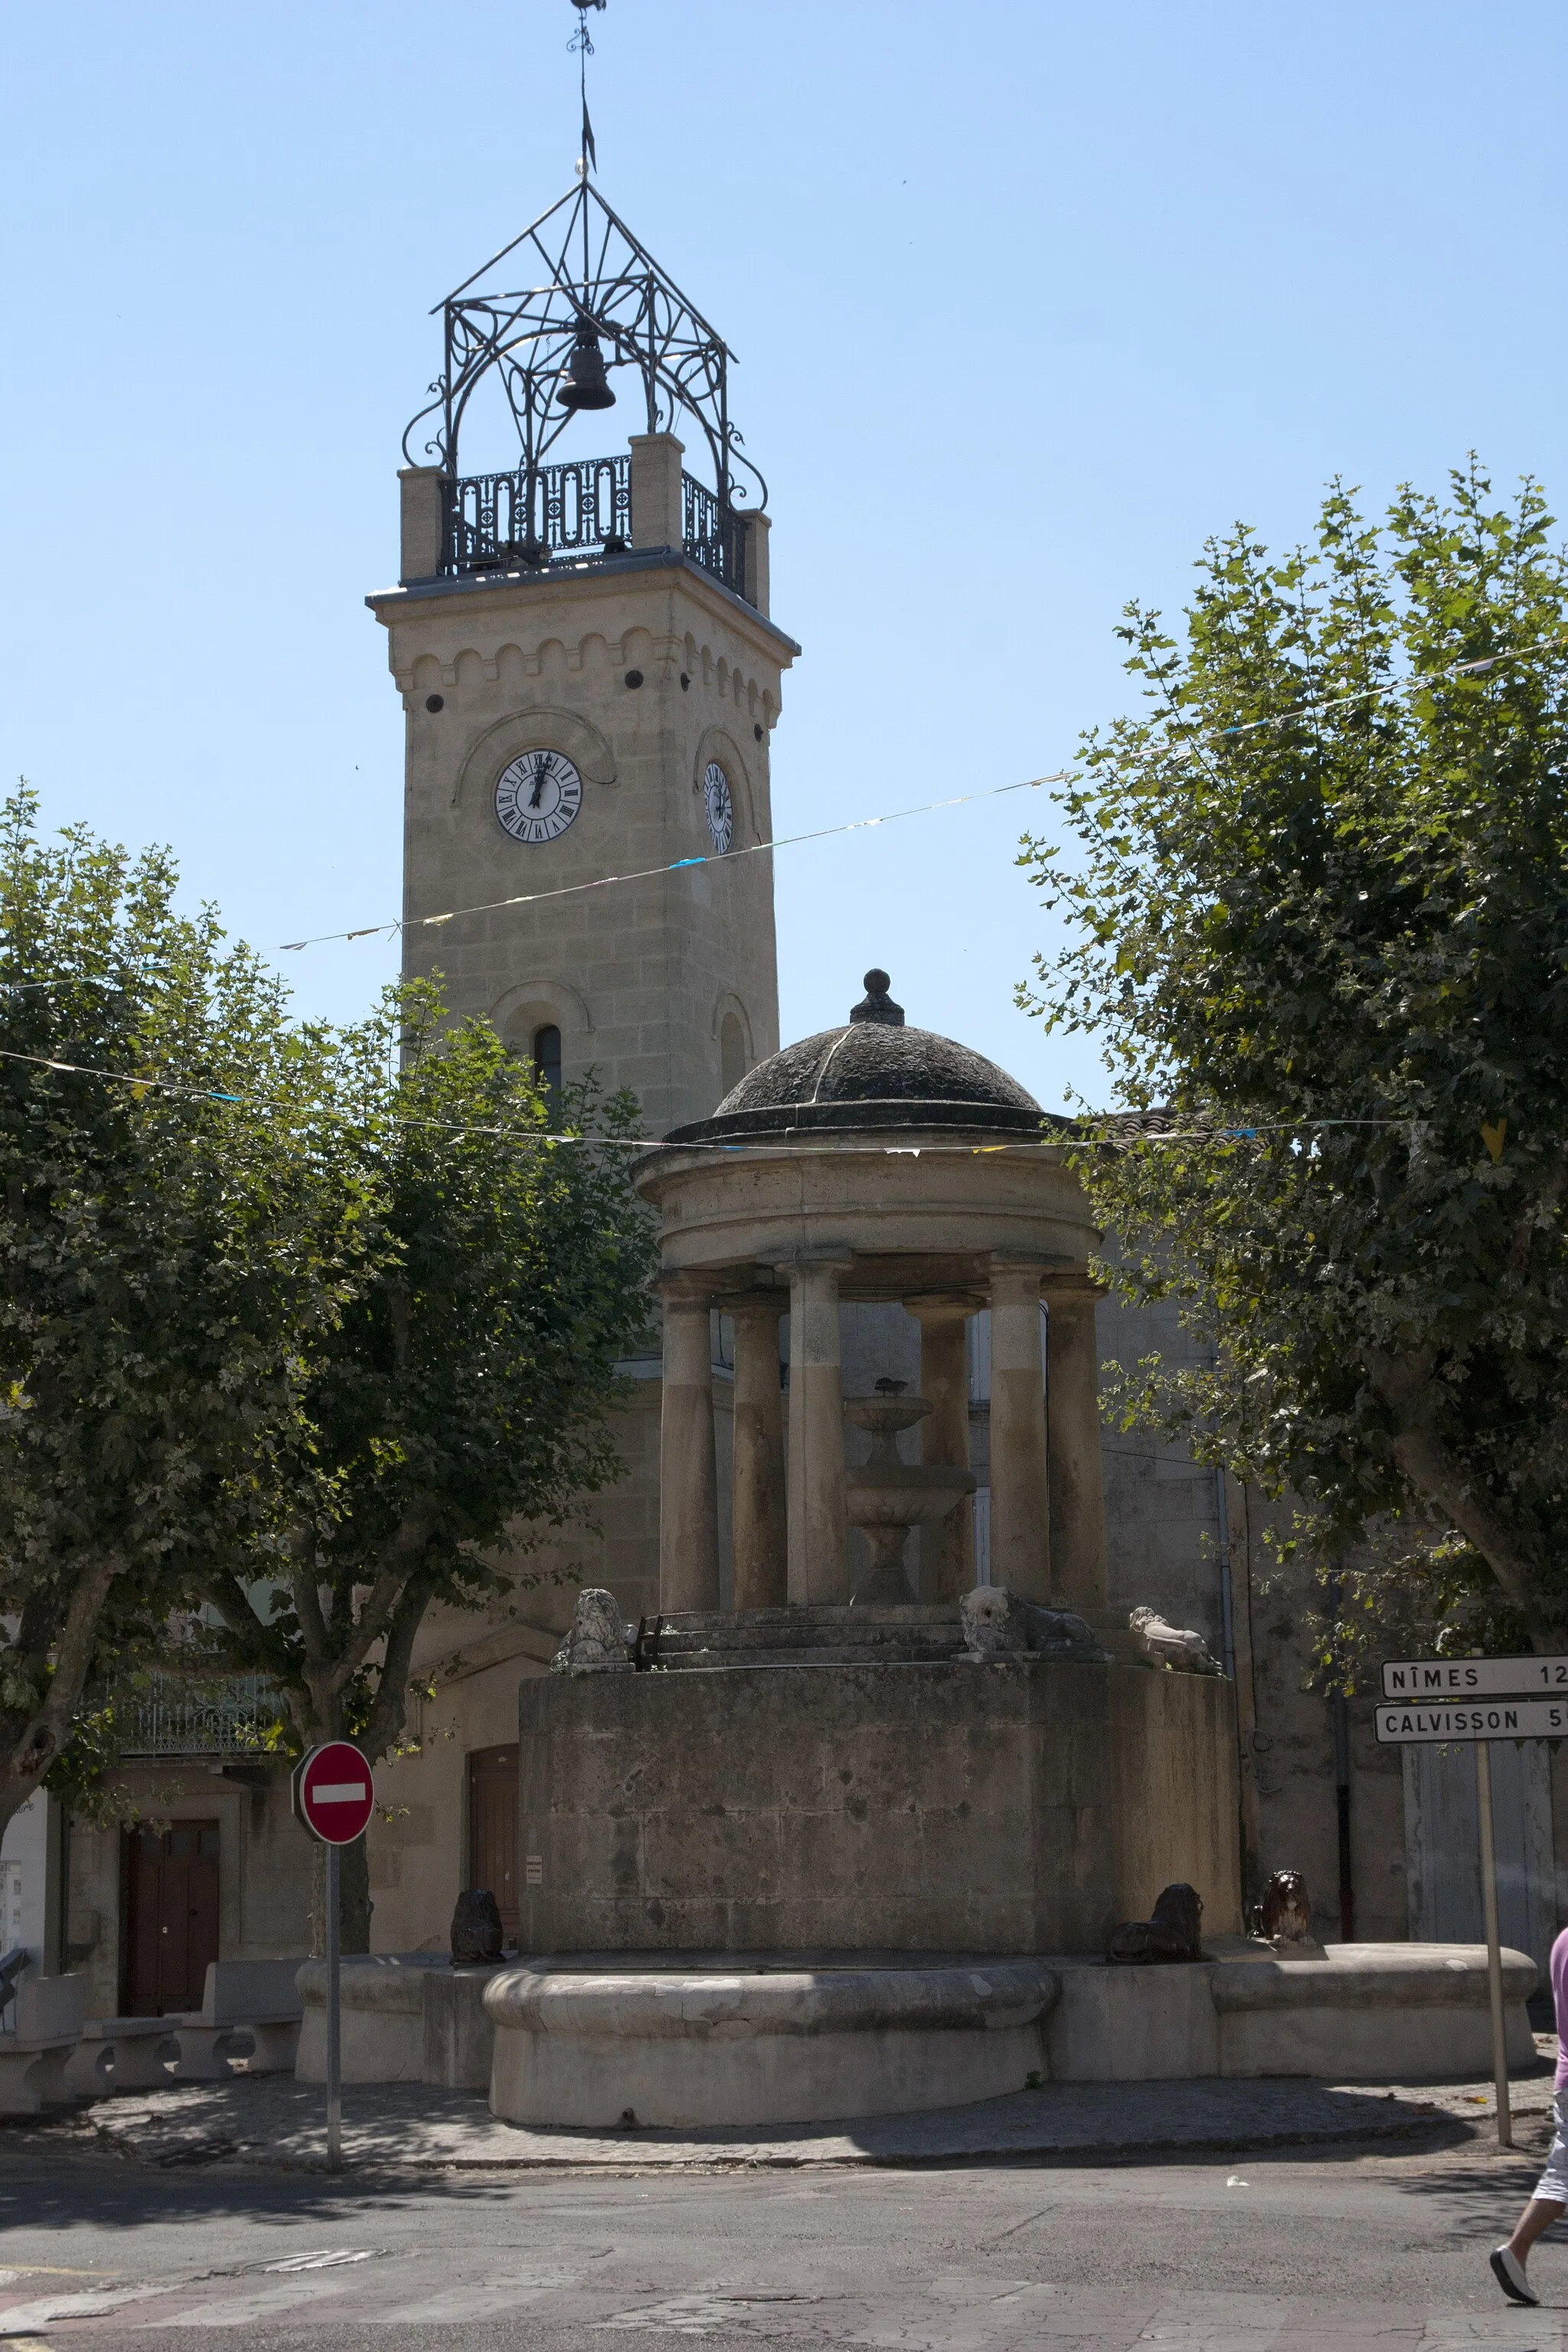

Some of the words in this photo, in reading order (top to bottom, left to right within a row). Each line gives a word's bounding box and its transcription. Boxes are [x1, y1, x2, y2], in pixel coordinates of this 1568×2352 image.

[516, 760, 528, 776] XI
[504, 776, 517, 787] X
[560, 770, 573, 782] II
[498, 795, 512, 804] IX
[535, 825, 543, 838] VI
[551, 820, 560, 833] V
[1392, 1667, 1478, 1688] NÎMES
[1540, 1665, 1568, 1684] 12
[1385, 1710, 1518, 1733] CALVISSON
